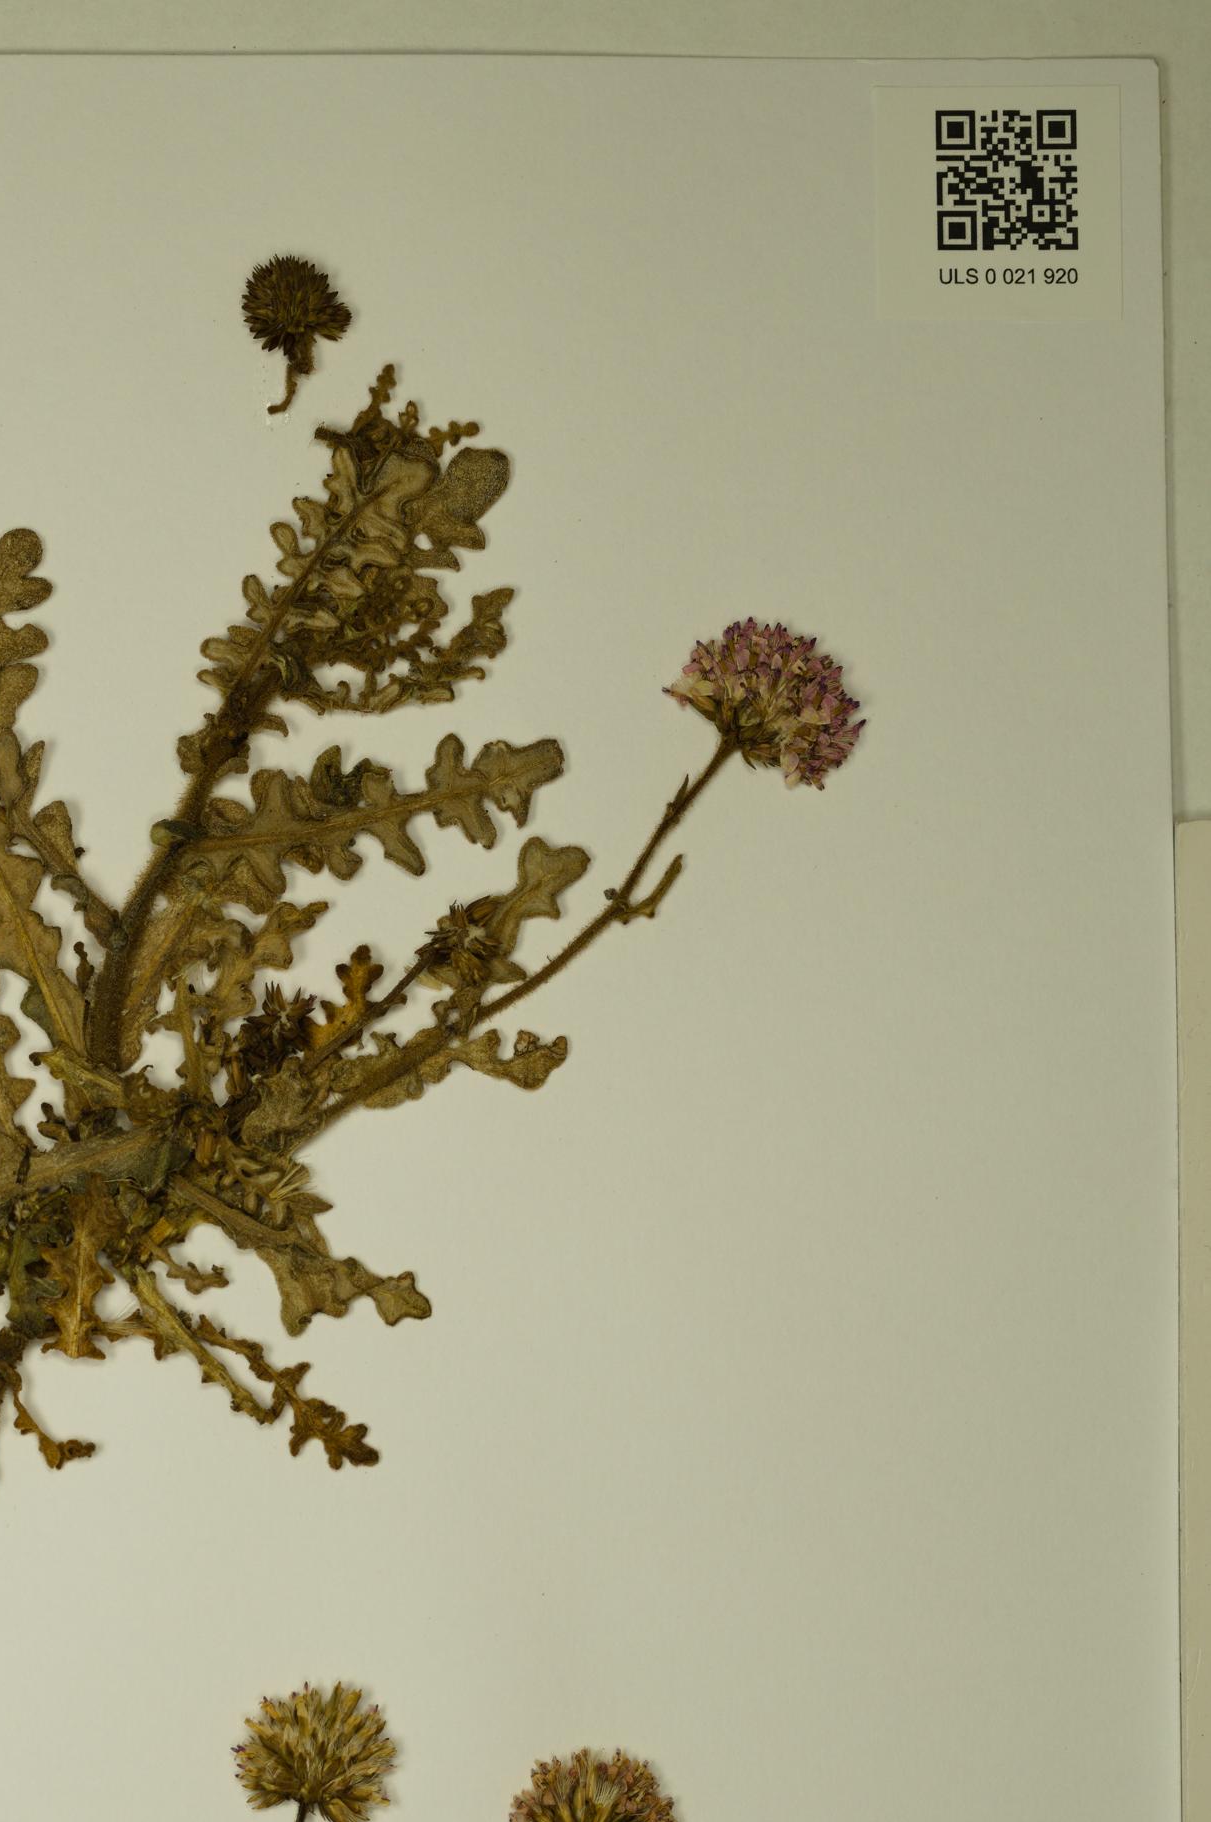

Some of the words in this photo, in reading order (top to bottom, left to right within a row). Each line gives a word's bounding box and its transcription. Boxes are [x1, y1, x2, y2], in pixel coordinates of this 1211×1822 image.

[939, 268, 979, 284] ULS
[985, 268, 996, 284] 0
[1003, 268, 1035, 284] 021
[1044, 268, 1078, 284] 920
